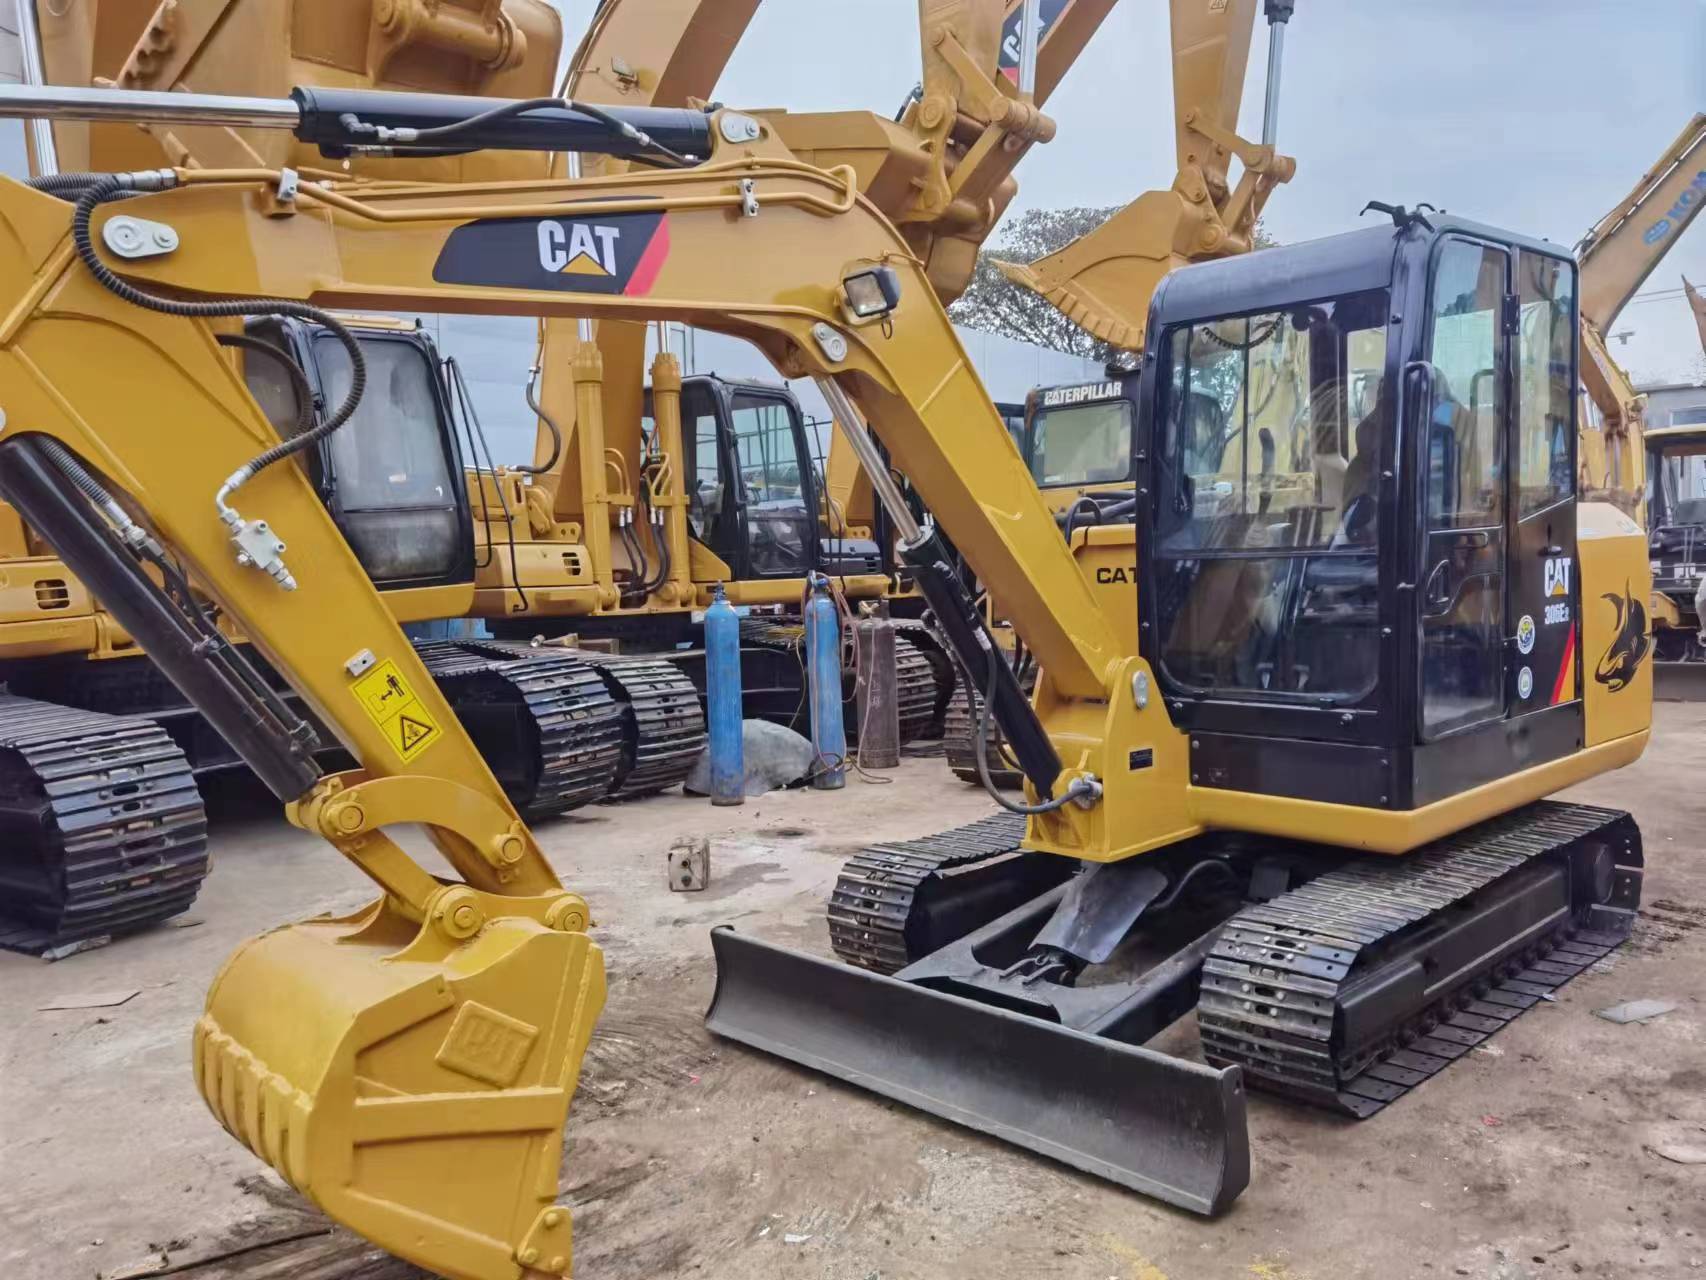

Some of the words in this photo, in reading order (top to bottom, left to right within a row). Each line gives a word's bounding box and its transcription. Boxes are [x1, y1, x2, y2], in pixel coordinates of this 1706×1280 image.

[537, 219, 620, 277] CAT
[1044, 381, 1122, 405] CATERPILLAR
[1096, 567, 1137, 584] CAT
[1544, 557, 1571, 598] CAT
